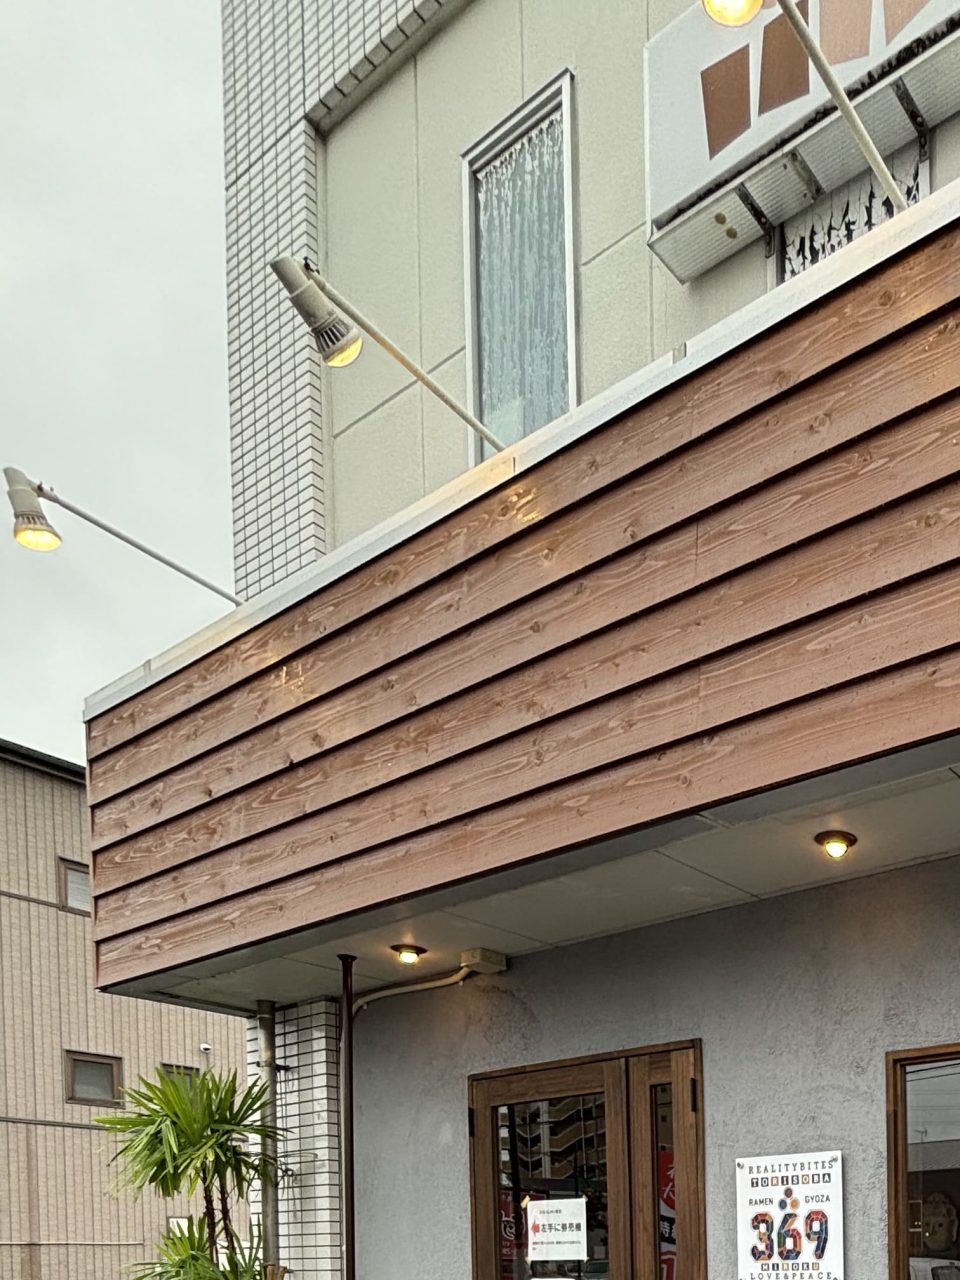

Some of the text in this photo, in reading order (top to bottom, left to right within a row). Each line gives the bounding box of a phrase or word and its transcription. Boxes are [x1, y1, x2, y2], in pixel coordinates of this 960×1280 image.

[750, 1172, 832, 1188] TORISOBA
[748, 1194, 831, 1206] RAMEN GYOZA
[541, 1222, 582, 1233] 左手に券売機
[751, 1210, 829, 1261] 369
[761, 1262, 820, 1272] MIROKU
